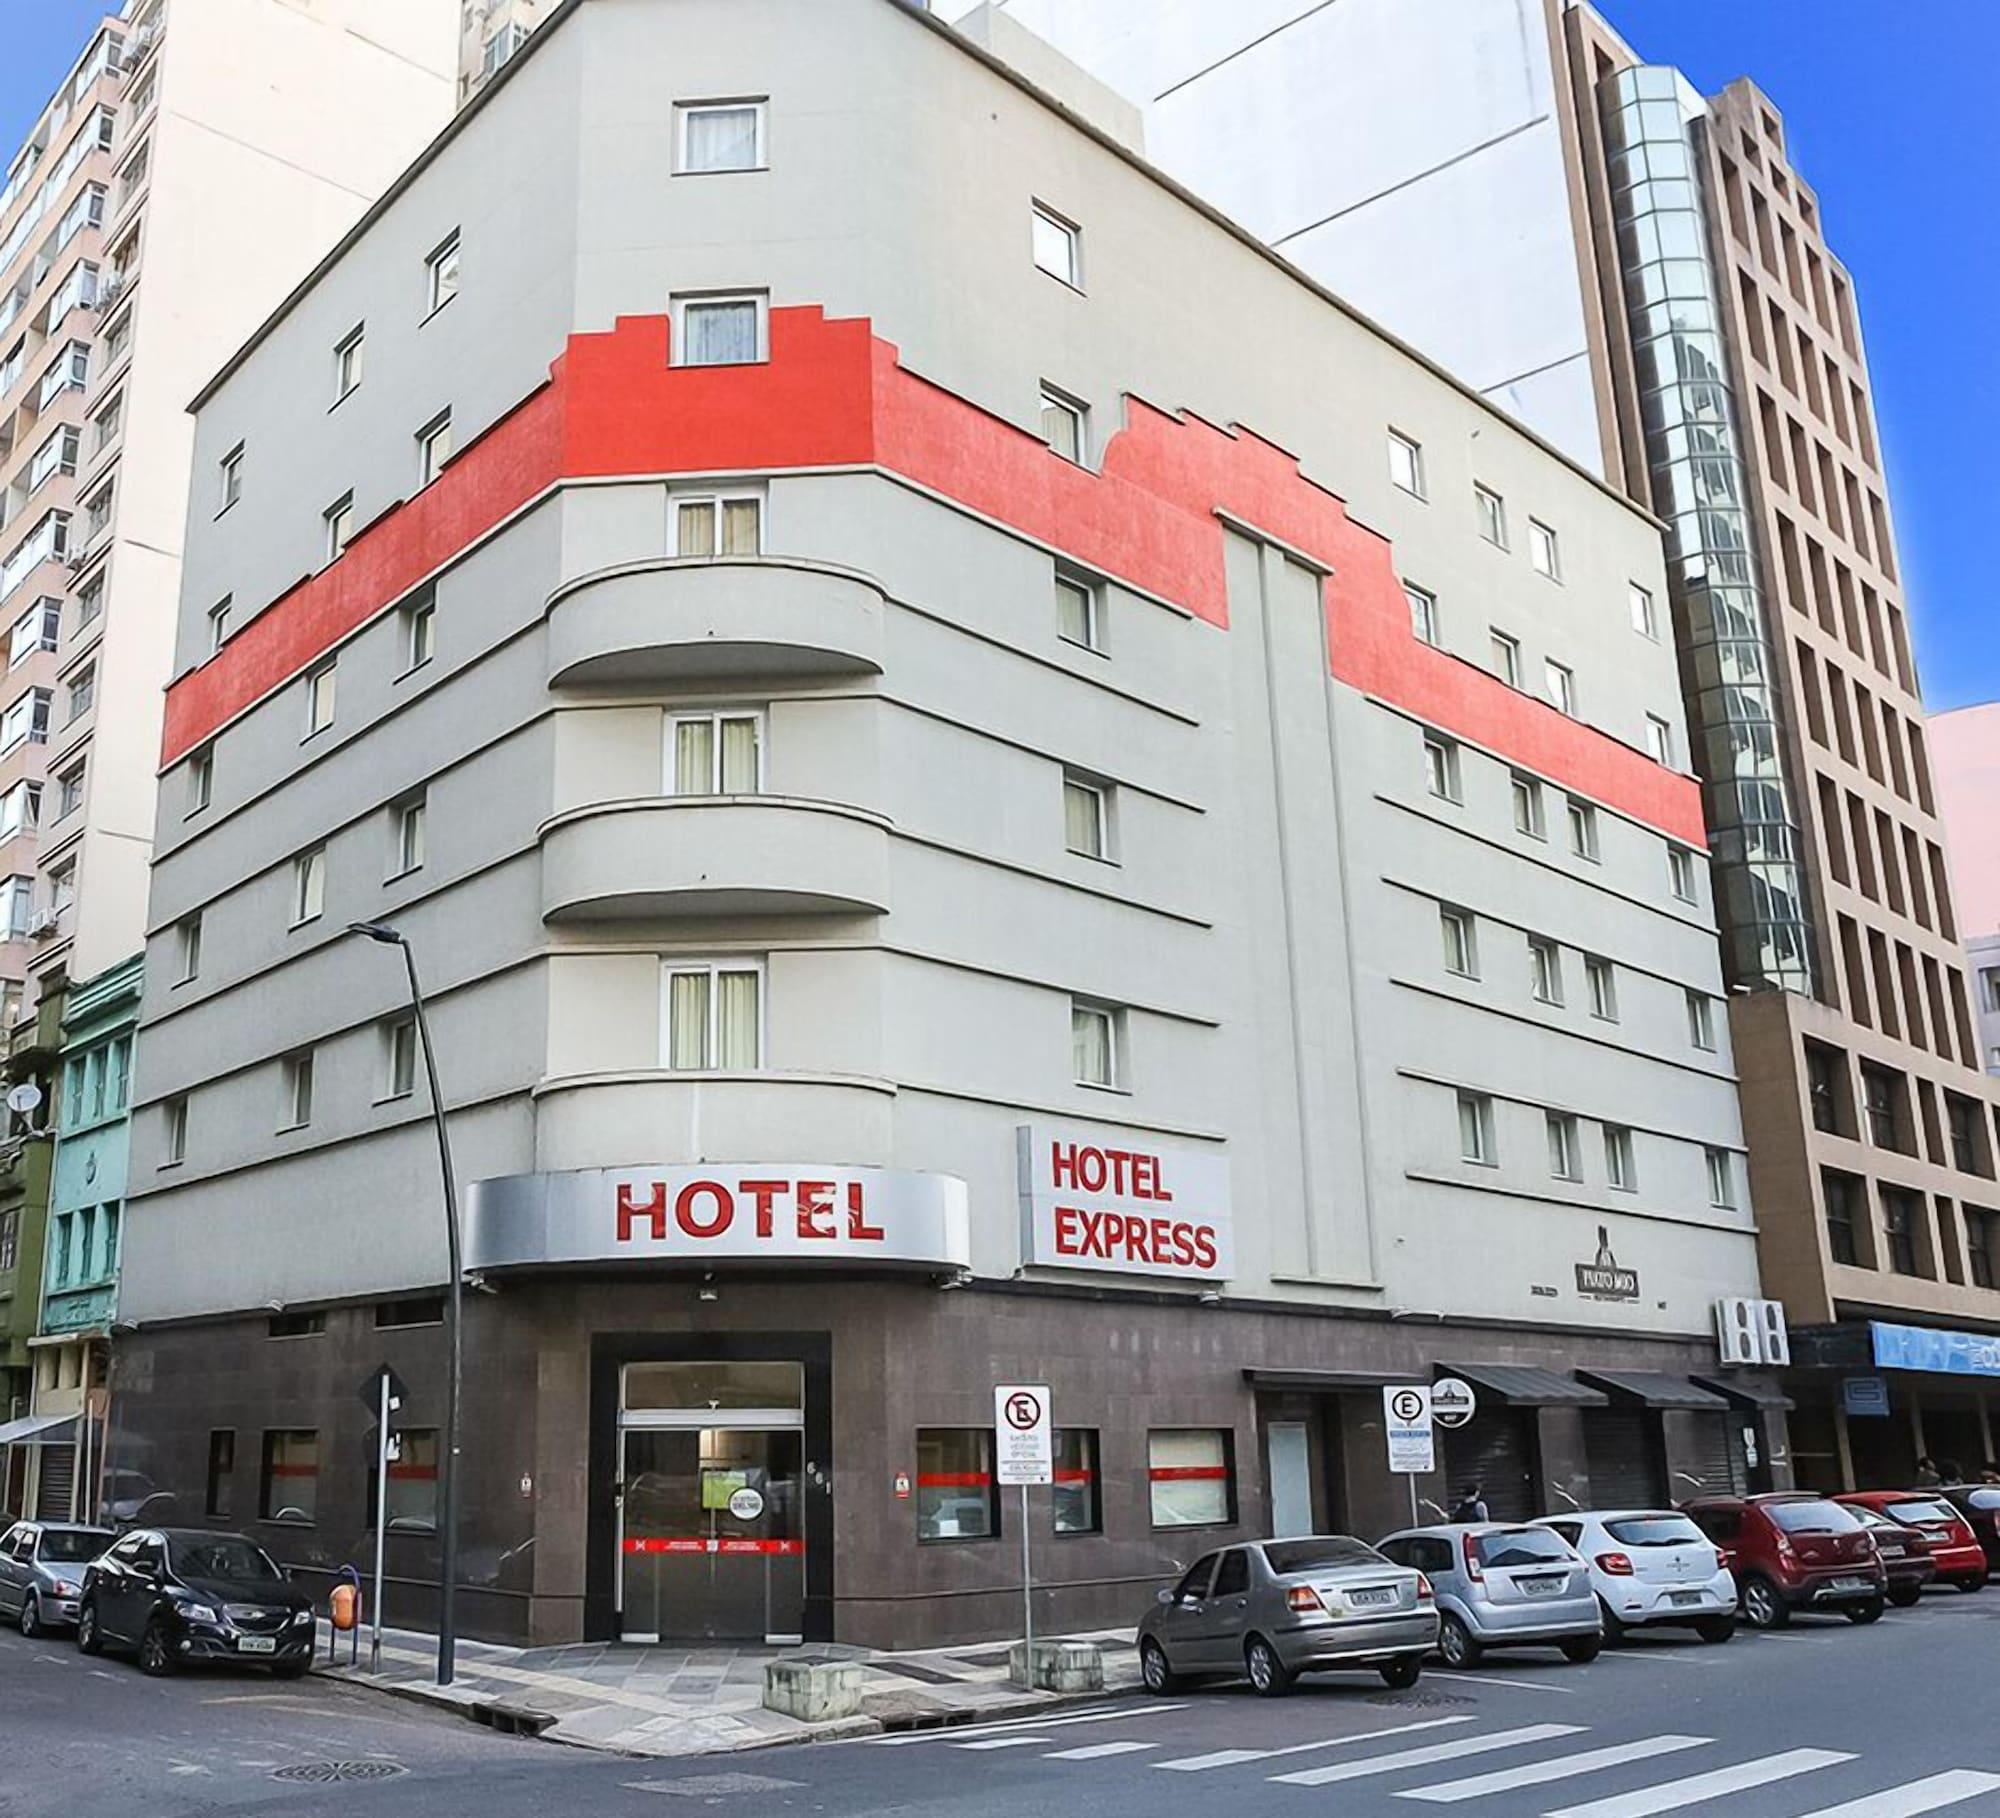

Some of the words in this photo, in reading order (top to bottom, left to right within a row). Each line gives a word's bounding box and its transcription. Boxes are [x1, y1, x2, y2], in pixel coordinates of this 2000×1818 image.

[1052, 1142, 1172, 1201] HOTEL
[616, 1180, 885, 1240] HOTEL
[1054, 1207, 1217, 1269] EXPRESS
[1401, 1397, 1414, 1414] E
